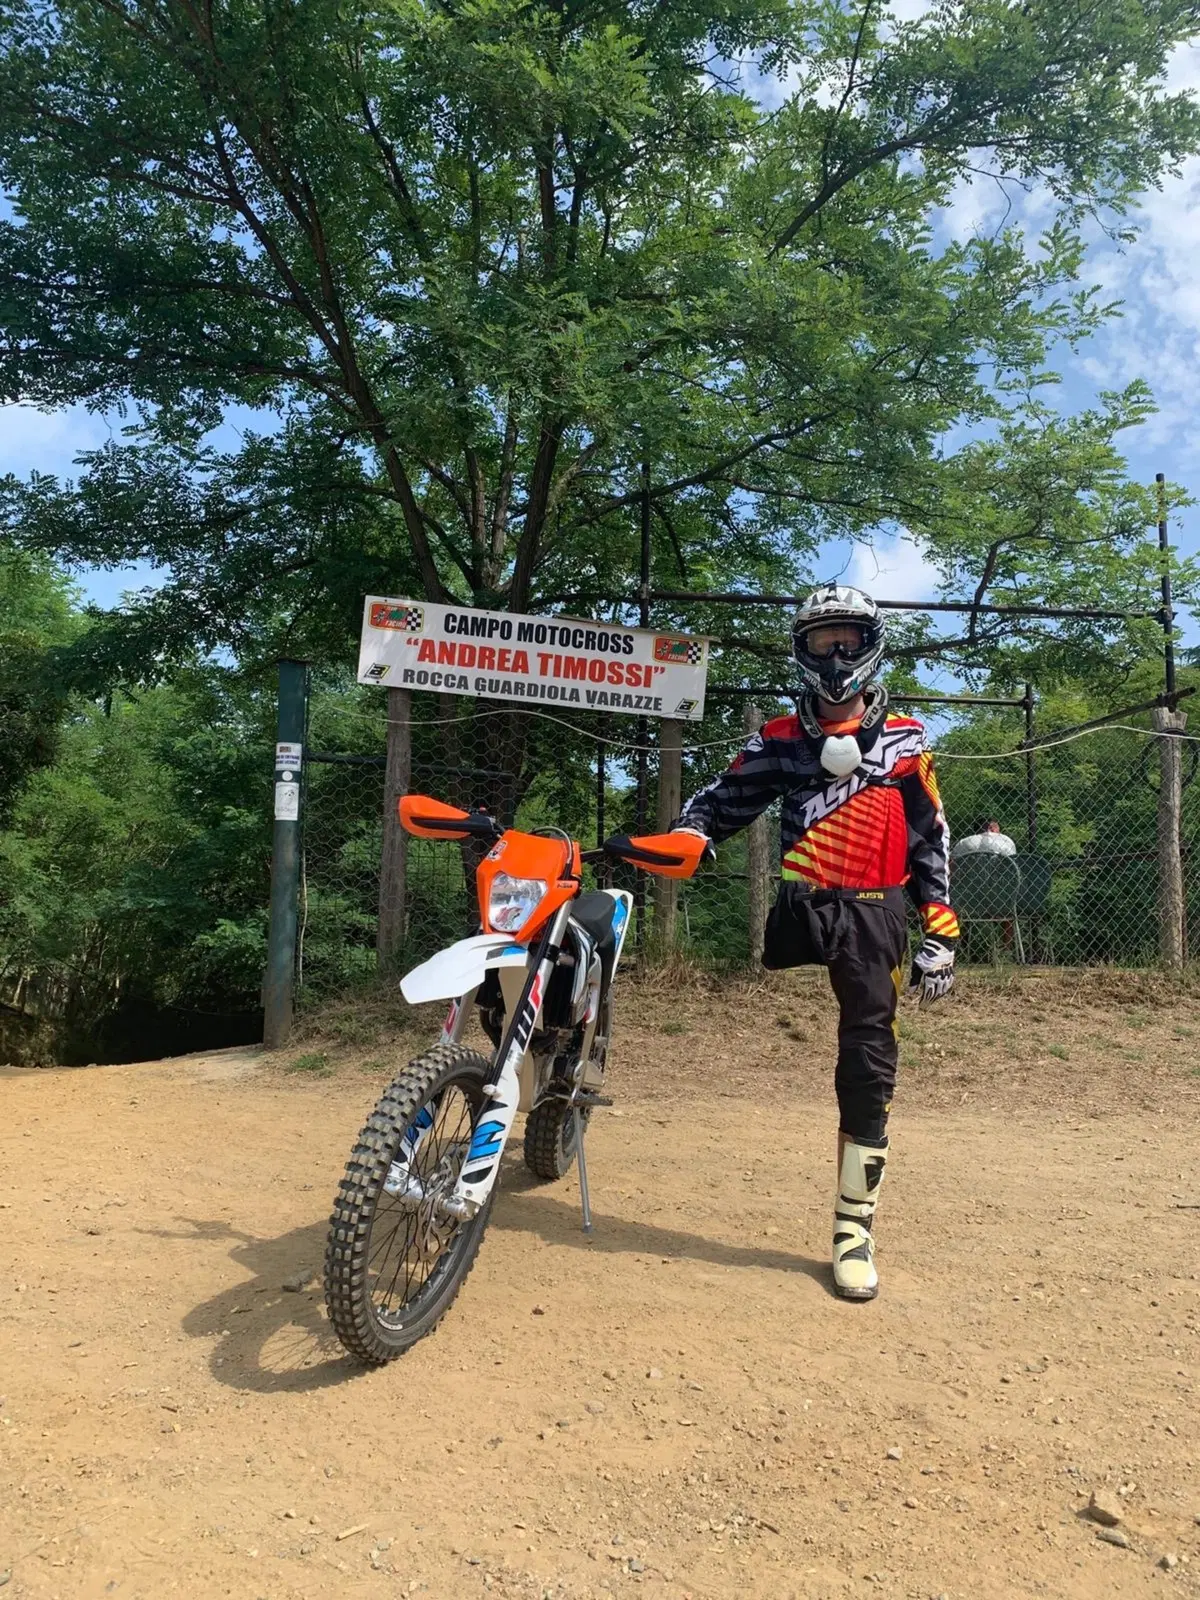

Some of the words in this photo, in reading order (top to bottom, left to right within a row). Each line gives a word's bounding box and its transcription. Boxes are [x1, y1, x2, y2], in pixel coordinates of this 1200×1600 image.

[444, 613, 512, 641] CAMPO
[517, 624, 634, 655] MOTOCROSS
[403, 668, 469, 690] ROCCA
[474, 676, 580, 702] GUARDIOLA
[585, 690, 662, 711] VARAZZE
[863, 706, 879, 729] UFO
